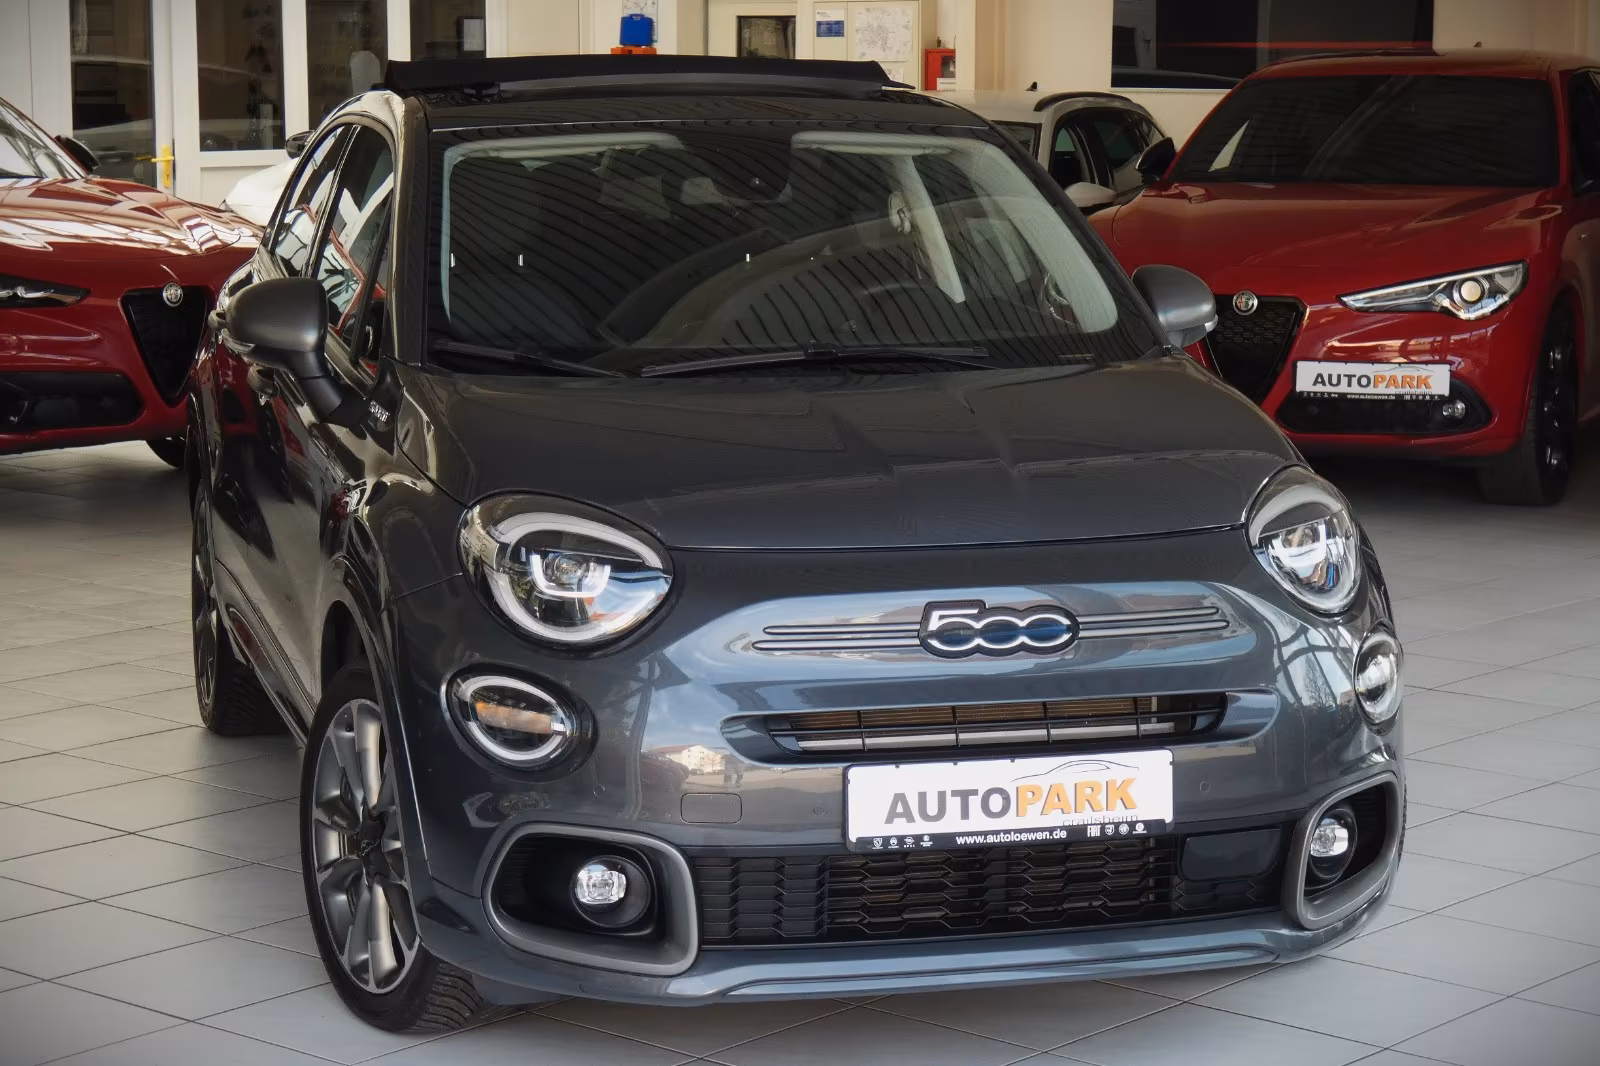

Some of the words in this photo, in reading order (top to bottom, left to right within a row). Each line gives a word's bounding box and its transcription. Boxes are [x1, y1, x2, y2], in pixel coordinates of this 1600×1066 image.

[1312, 372, 1433, 390] AUTOPARK
[927, 608, 1073, 651] 500
[884, 777, 1138, 825] AUTOPARK
[955, 828, 1067, 845] www.autoloewen.de
